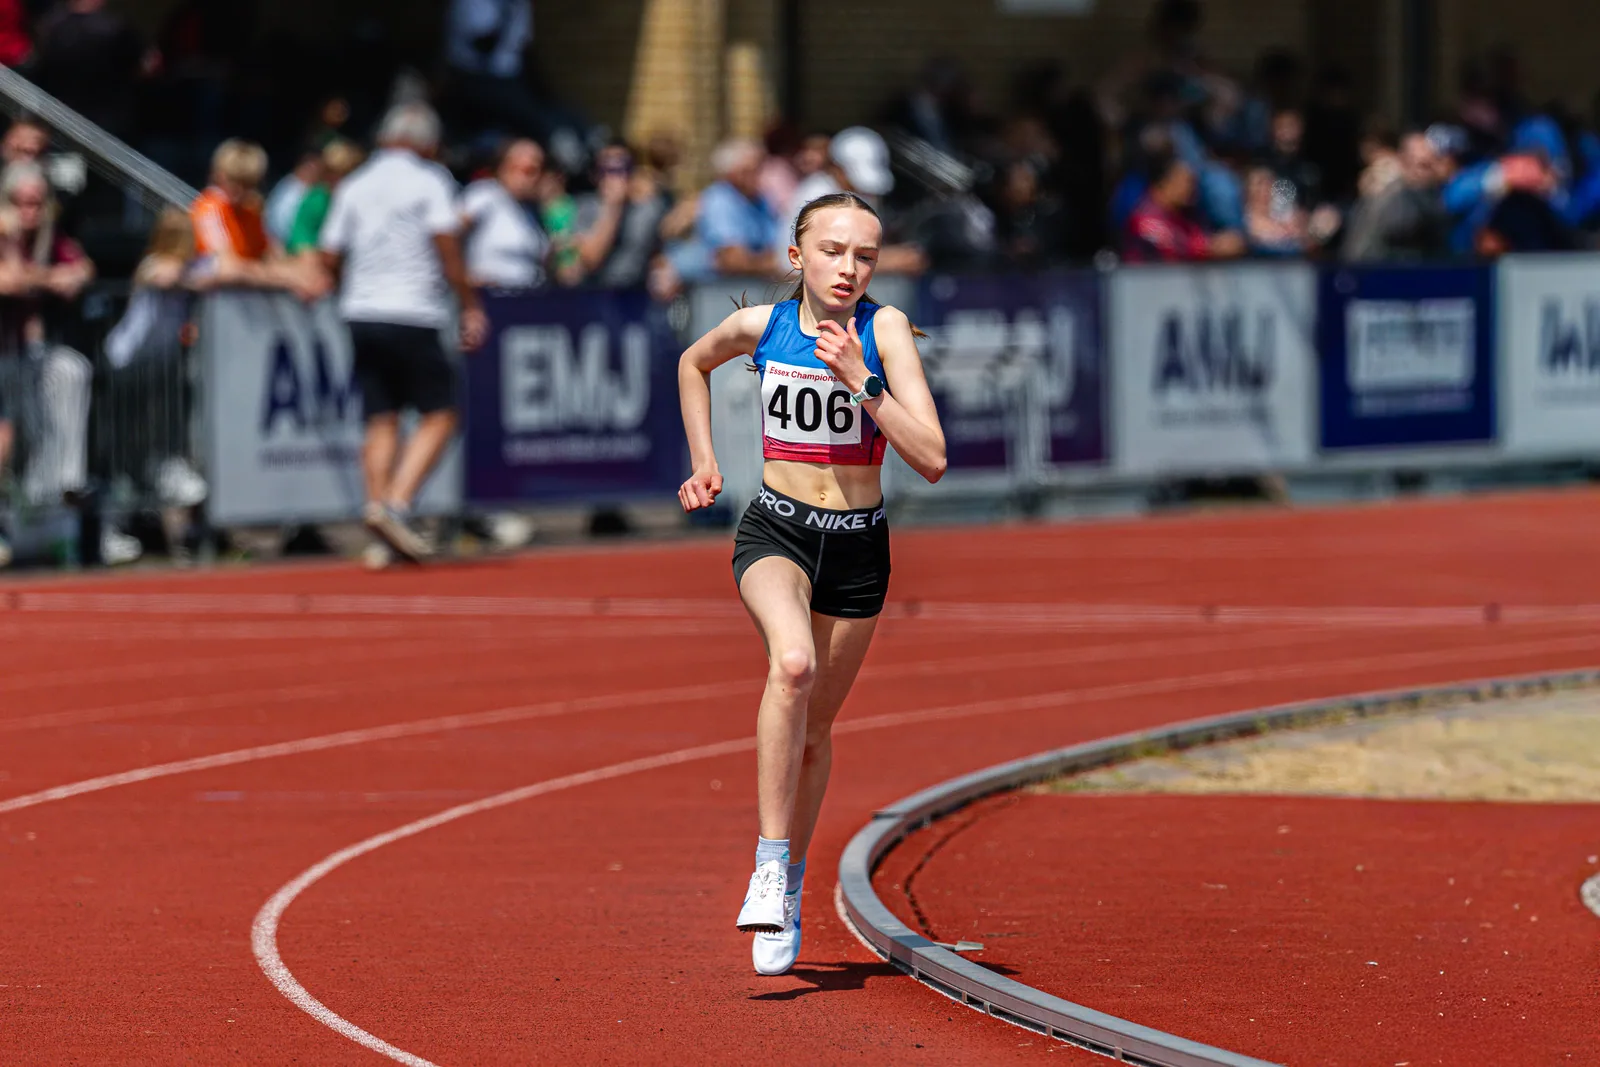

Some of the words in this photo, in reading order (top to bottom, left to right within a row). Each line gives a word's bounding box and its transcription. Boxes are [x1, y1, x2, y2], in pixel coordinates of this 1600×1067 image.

[769, 366, 790, 377] Essex
[768, 384, 854, 434] 406
[805, 510, 868, 530] NIKE
